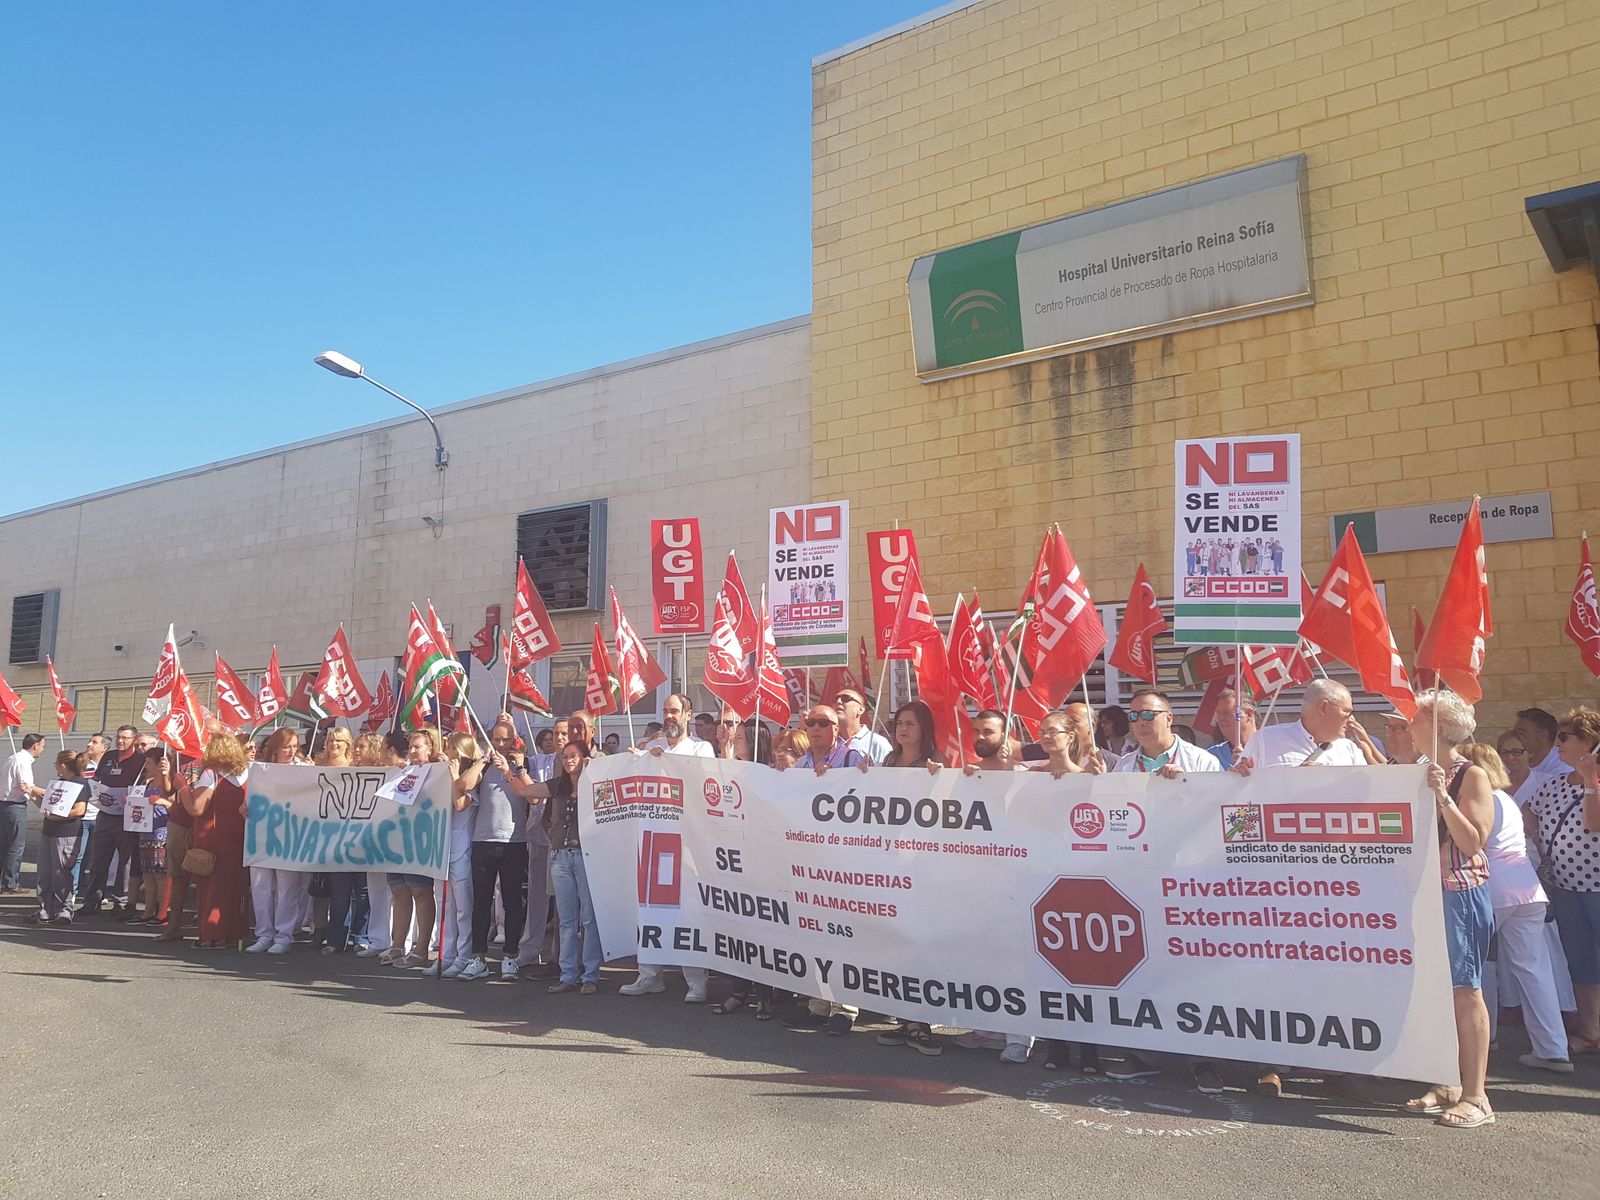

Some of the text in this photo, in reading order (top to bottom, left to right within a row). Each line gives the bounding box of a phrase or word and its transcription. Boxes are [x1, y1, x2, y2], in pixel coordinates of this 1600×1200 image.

[1059, 220, 1275, 283] Hospital Universitario Reina Sofía
[1034, 250, 1278, 315] Centro Provincial de Procesado de Ropa Hospitalaria
[1185, 440, 1289, 486] NO
[1185, 492, 1219, 510] SE
[1491, 507, 1506, 518] de
[1510, 505, 1539, 518] Ropa
[776, 506, 841, 545] NO
[1184, 515, 1278, 534] VENDE
[662, 524, 694, 600] UGT
[775, 548, 797, 564] SE
[774, 564, 834, 582] VENDE
[1211, 581, 1269, 594] CCOO
[793, 605, 830, 618] CCOO
[318, 772, 386, 819] NO
[595, 806, 628, 818] sindicato
[649, 812, 680, 821] Córdoba
[811, 788, 993, 831] CÓRDOBA
[1074, 808, 1129, 824] UGT FSP
[1272, 812, 1376, 834] CCOO
[785, 829, 1028, 858] sindicato de sanidad y sectores sociosanitarios
[1225, 843, 1412, 856] sindicato de sanidad y sectores
[715, 847, 743, 873] SE
[1226, 853, 1395, 864] sociosanitarios de Córdoba
[791, 865, 912, 889] NI LAVANDERIAS
[1161, 876, 1361, 897] Privatizaciones
[698, 882, 790, 925] VENDEN
[795, 891, 897, 917] NI ALMACENES
[798, 916, 854, 938] DEL SAS
[1164, 906, 1397, 930] Externalizaciones
[1042, 911, 1136, 953] STOP
[1168, 937, 1413, 966] Subcontrataciones
[673, 927, 707, 952] EL
[714, 932, 807, 978] EMPLEO
[815, 957, 833, 984] Y
[843, 962, 1027, 1017] DERECHOS
[1040, 990, 1093, 1023] EN
[1108, 996, 1163, 1030] LA
[1176, 1002, 1381, 1052] SANIDAD
